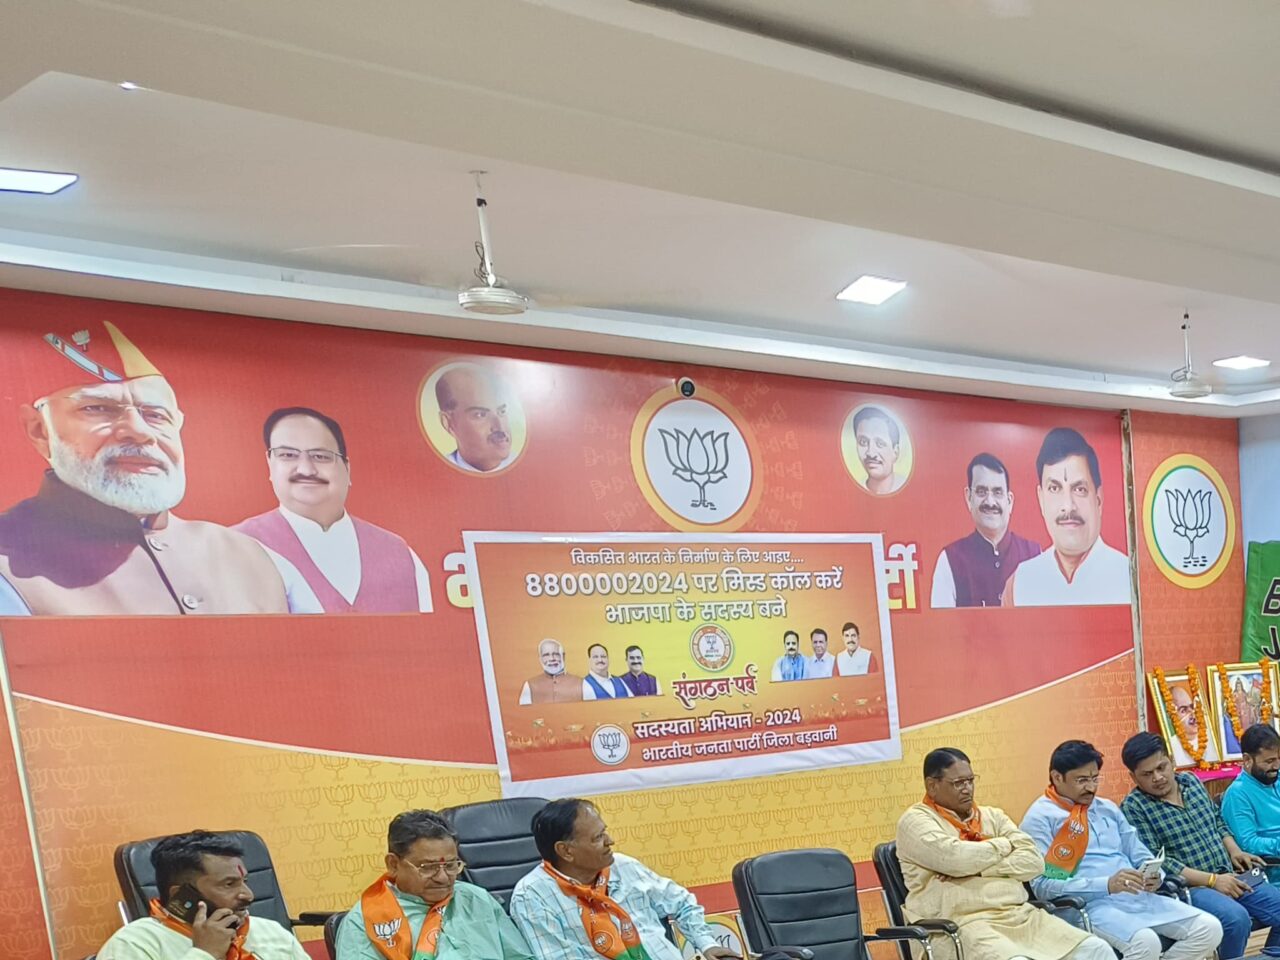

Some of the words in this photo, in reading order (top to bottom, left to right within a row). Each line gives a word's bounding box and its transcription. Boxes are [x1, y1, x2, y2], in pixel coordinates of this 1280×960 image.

[570, 547, 625, 565] विकसित
[628, 550, 660, 565] भारत
[663, 548, 676, 564] के
[679, 547, 720, 564] निर्माण
[721, 548, 735, 564] के
[737, 547, 760, 563] लिए
[525, 572, 689, 596] 8800002024
[692, 573, 718, 593] पर
[721, 567, 767, 592] मिस्ड
[768, 566, 811, 590] कॉल
[814, 565, 844, 589] करें
[605, 602, 671, 624] भाजपा
[674, 597, 696, 621] के
[699, 599, 754, 621] सदस्य
[757, 594, 787, 618] बने
[672, 671, 731, 707] संगठन
[633, 718, 696, 738] सदस्यता
[698, 710, 752, 732] अभियान
[765, 709, 801, 726] 2024
[642, 741, 692, 761] भारतीय
[694, 739, 732, 756] जनता
[733, 732, 761, 751] पार्टी
[763, 731, 794, 748] जिला
[795, 724, 837, 747] बड़वानी
